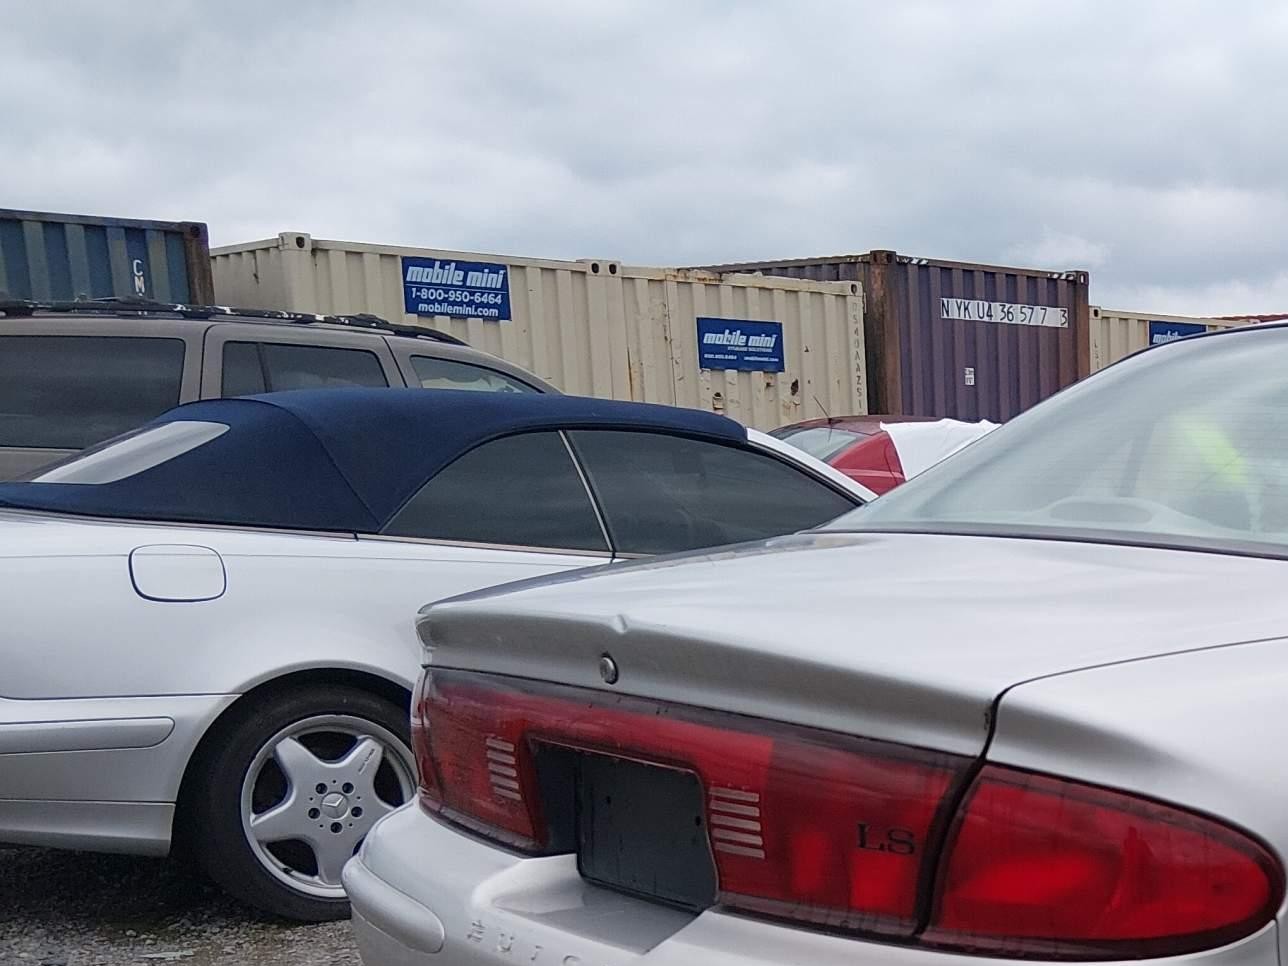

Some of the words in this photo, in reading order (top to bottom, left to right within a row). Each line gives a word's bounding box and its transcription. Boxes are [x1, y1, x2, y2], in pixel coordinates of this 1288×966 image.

[132, 259, 145, 297] CM
[406, 260, 465, 286] mobile
[466, 269, 504, 288] mini
[411, 287, 502, 304] 1-800-950-6464
[418, 302, 499, 317] mobilemini.com
[703, 329, 747, 346] mobile
[748, 334, 777, 348] mini
[856, 823, 914, 855] LS
